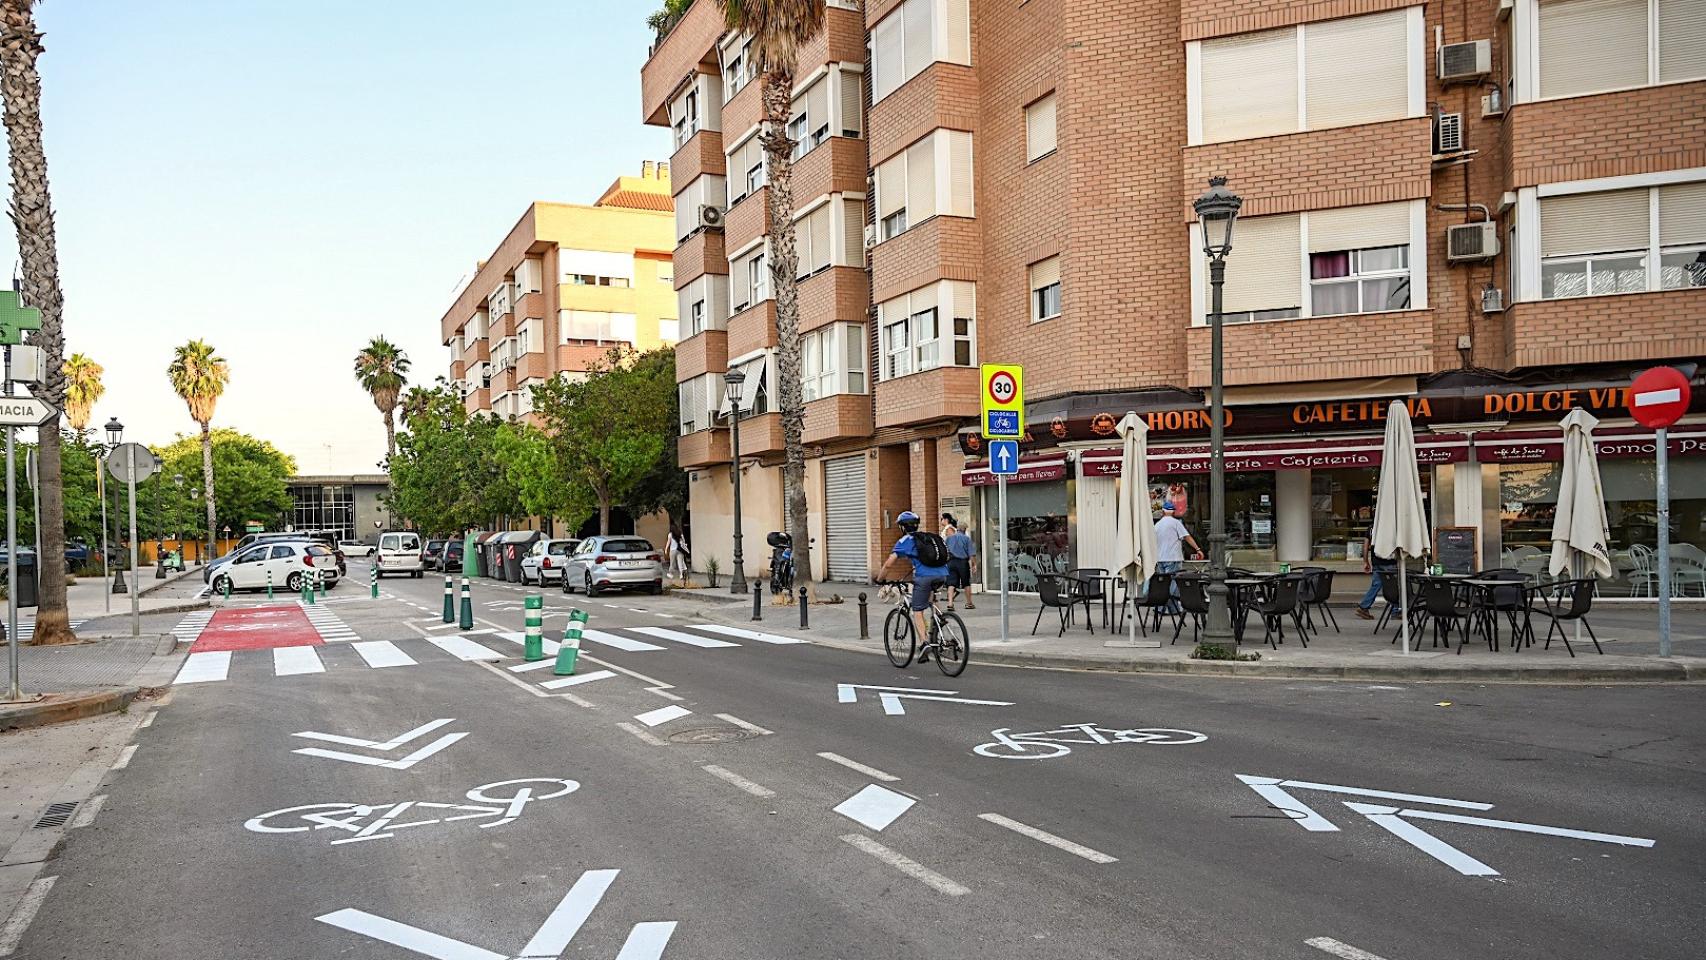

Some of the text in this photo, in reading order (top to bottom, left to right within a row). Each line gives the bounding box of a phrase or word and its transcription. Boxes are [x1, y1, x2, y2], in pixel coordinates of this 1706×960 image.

[995, 382, 1011, 393] 30
[1293, 398, 1432, 424] CAFETEIA
[1484, 387, 1633, 414] DOLCE VIT
[1167, 459, 1262, 472] Pastería
[1281, 454, 1369, 467] Cafetería
